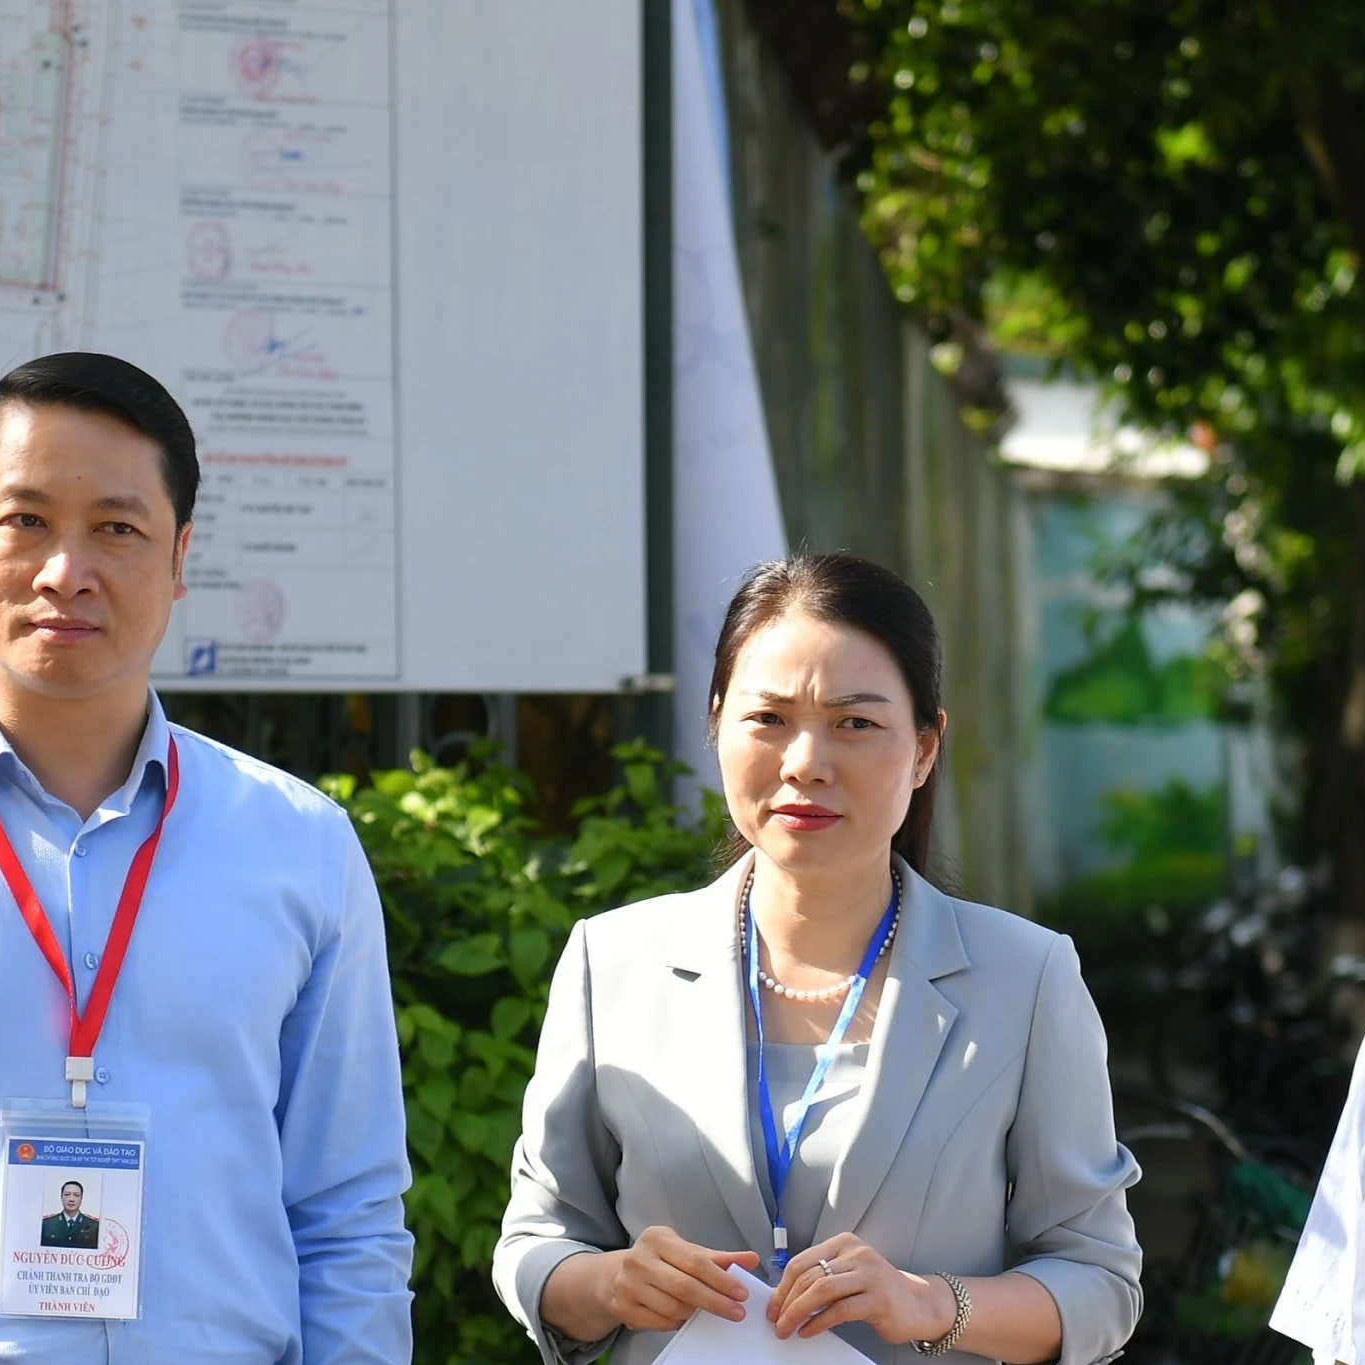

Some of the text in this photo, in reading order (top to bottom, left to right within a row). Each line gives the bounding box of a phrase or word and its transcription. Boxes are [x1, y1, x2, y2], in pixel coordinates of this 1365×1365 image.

[43, 1144, 54, 1154] BỘ
[56, 1144, 74, 1154] GIÁO
[75, 1146, 91, 1156] DỤC
[92, 1147, 102, 1155] VÀ
[60, 1251, 84, 1265] ĐỨC
[17, 1268, 44, 1280] CHÁNH
[45, 1271, 72, 1282] THANH
[73, 1272, 88, 1282] TRA
[89, 1272, 100, 1285] BỘ
[40, 1282, 59, 1295] VIÊN
[60, 1286, 75, 1295] BAN
[93, 1287, 110, 1299] ĐẠO
[73, 1301, 95, 1312] VIÊN
